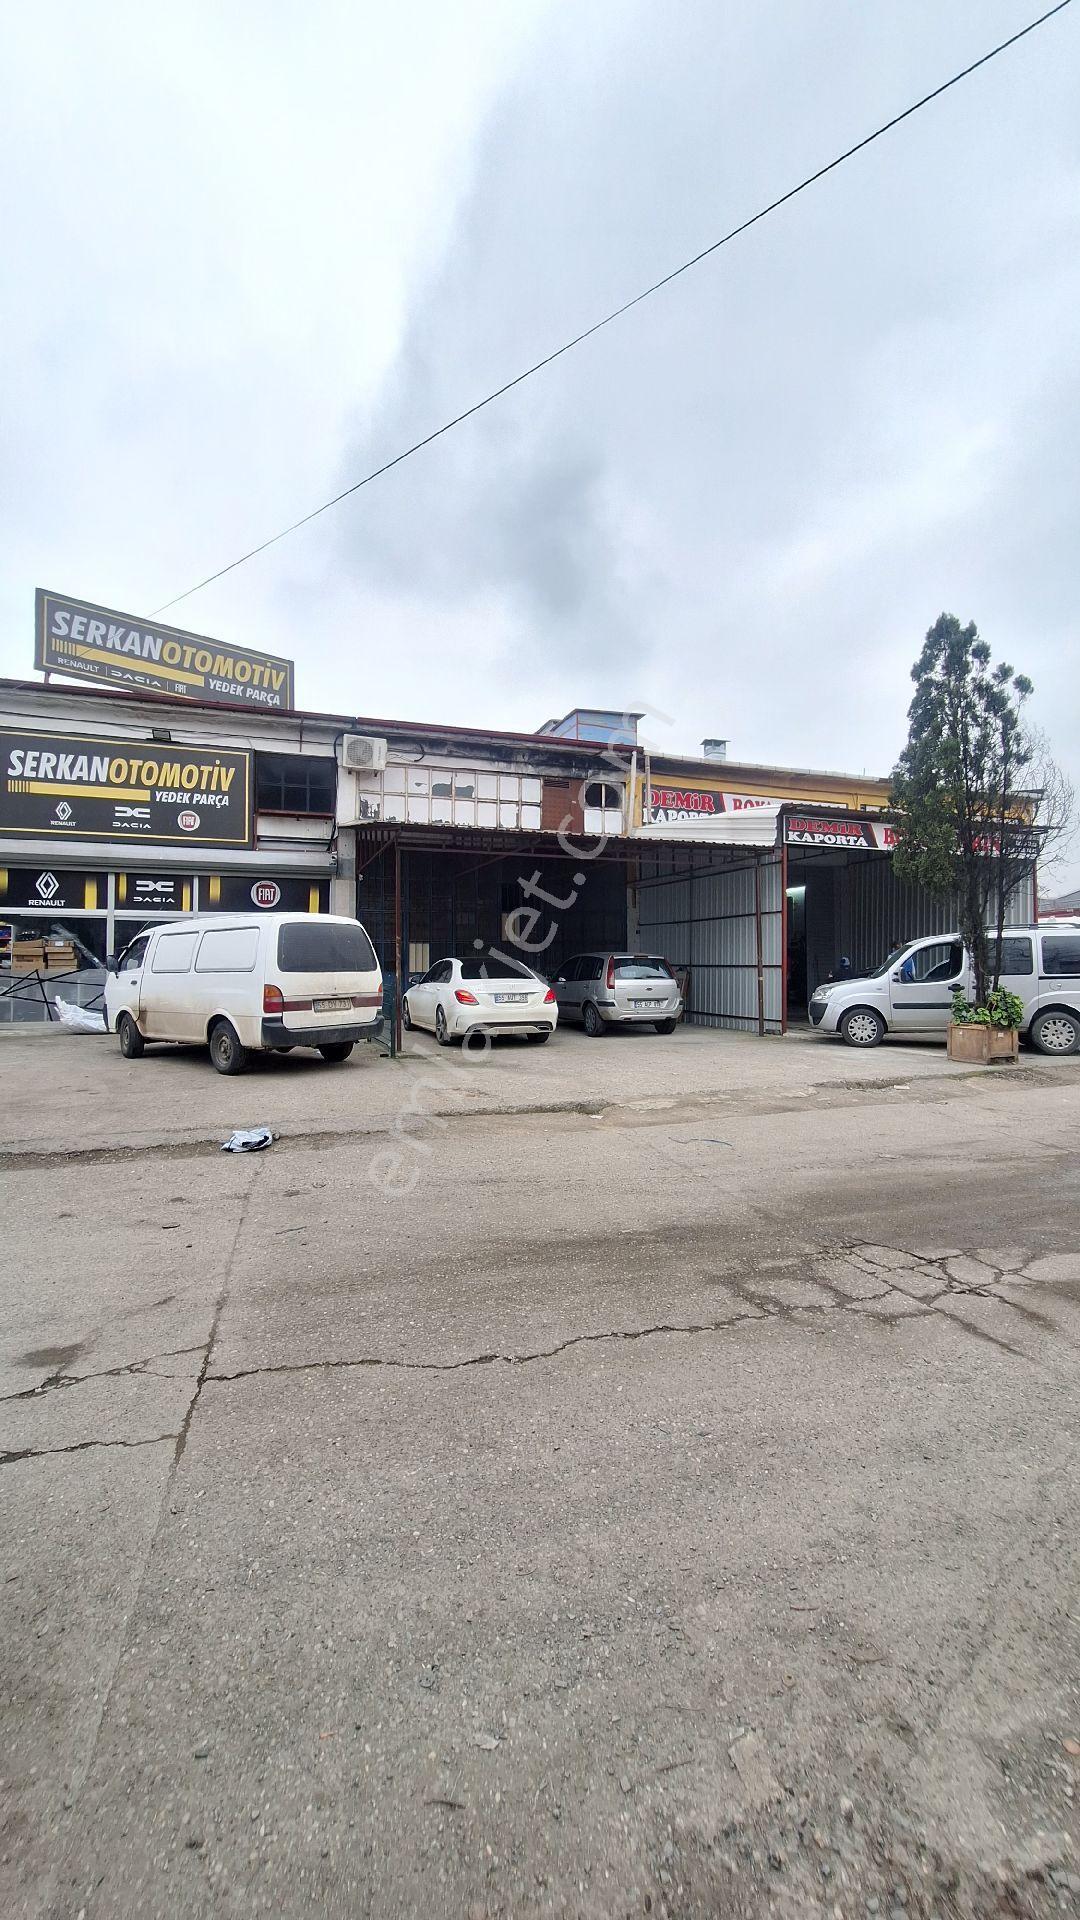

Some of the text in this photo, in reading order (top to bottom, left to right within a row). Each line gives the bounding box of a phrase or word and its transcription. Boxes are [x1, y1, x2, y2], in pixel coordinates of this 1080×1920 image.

[57, 657, 99, 673] RENAULT
[110, 670, 162, 688] DACIA
[208, 678, 280, 707] YEDEK PARÇA
[155, 791, 229, 808] YEDEK PARÇA
[112, 821, 152, 829] DACIA
[787, 831, 869, 847] KAPORTA
[258, 887, 275, 902] FIAT
[28, 899, 66, 907] RENAULT
